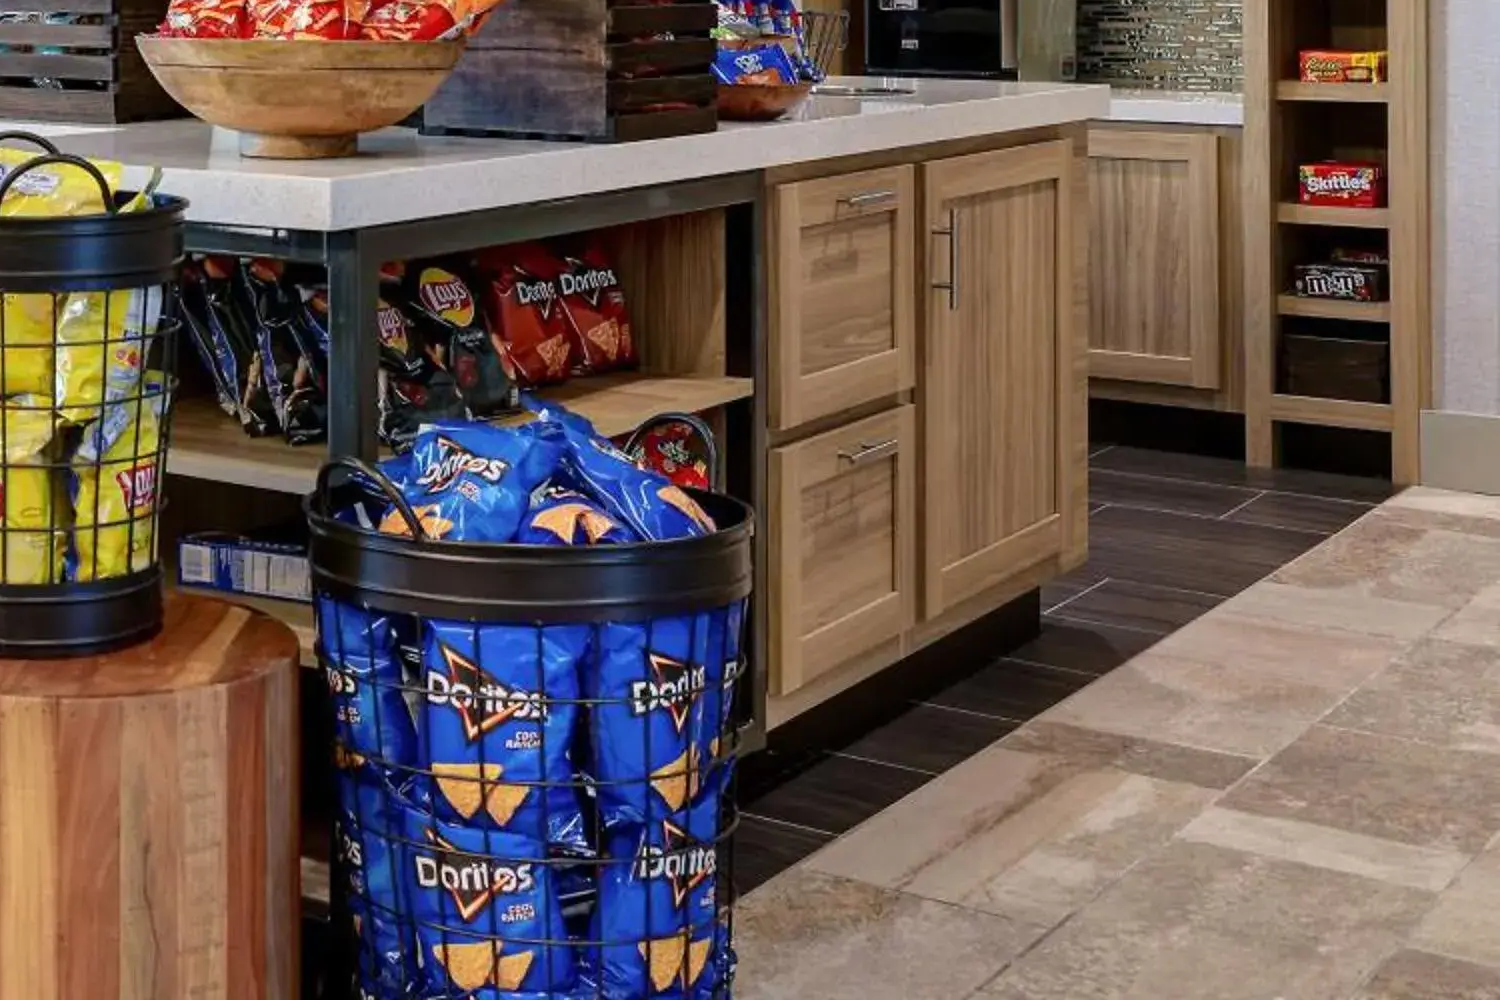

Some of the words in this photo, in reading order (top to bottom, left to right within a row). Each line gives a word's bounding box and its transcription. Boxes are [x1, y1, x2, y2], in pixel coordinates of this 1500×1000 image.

[1307, 173, 1371, 194] Skittles
[560, 269, 617, 295] Doritos
[427, 670, 550, 719] Doritos
[416, 855, 533, 893] Doritos
